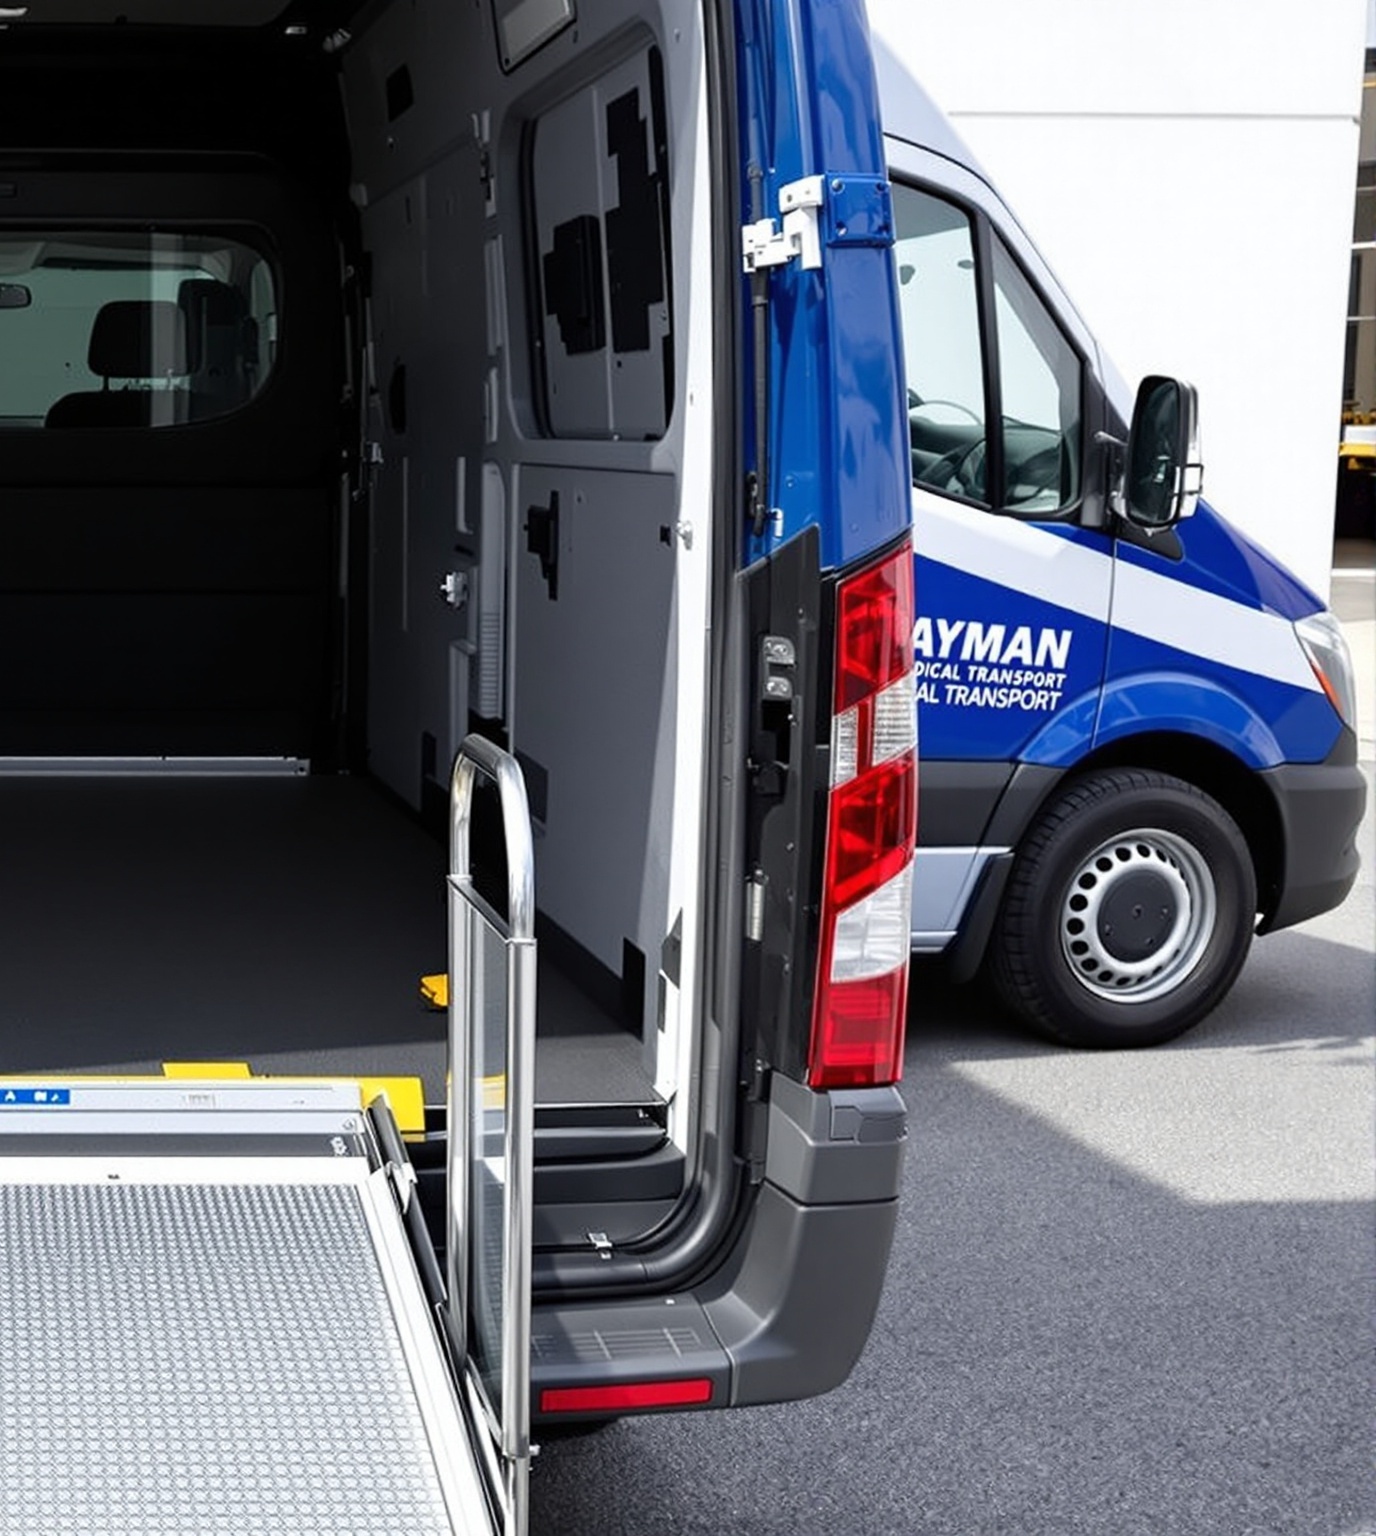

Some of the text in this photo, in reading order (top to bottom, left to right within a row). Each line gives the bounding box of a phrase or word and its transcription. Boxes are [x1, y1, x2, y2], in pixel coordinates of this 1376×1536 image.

[912, 616, 1073, 669] AYMAN
[968, 666, 1066, 689] TRANSPORT
[945, 684, 1062, 711] TRANSPORT
